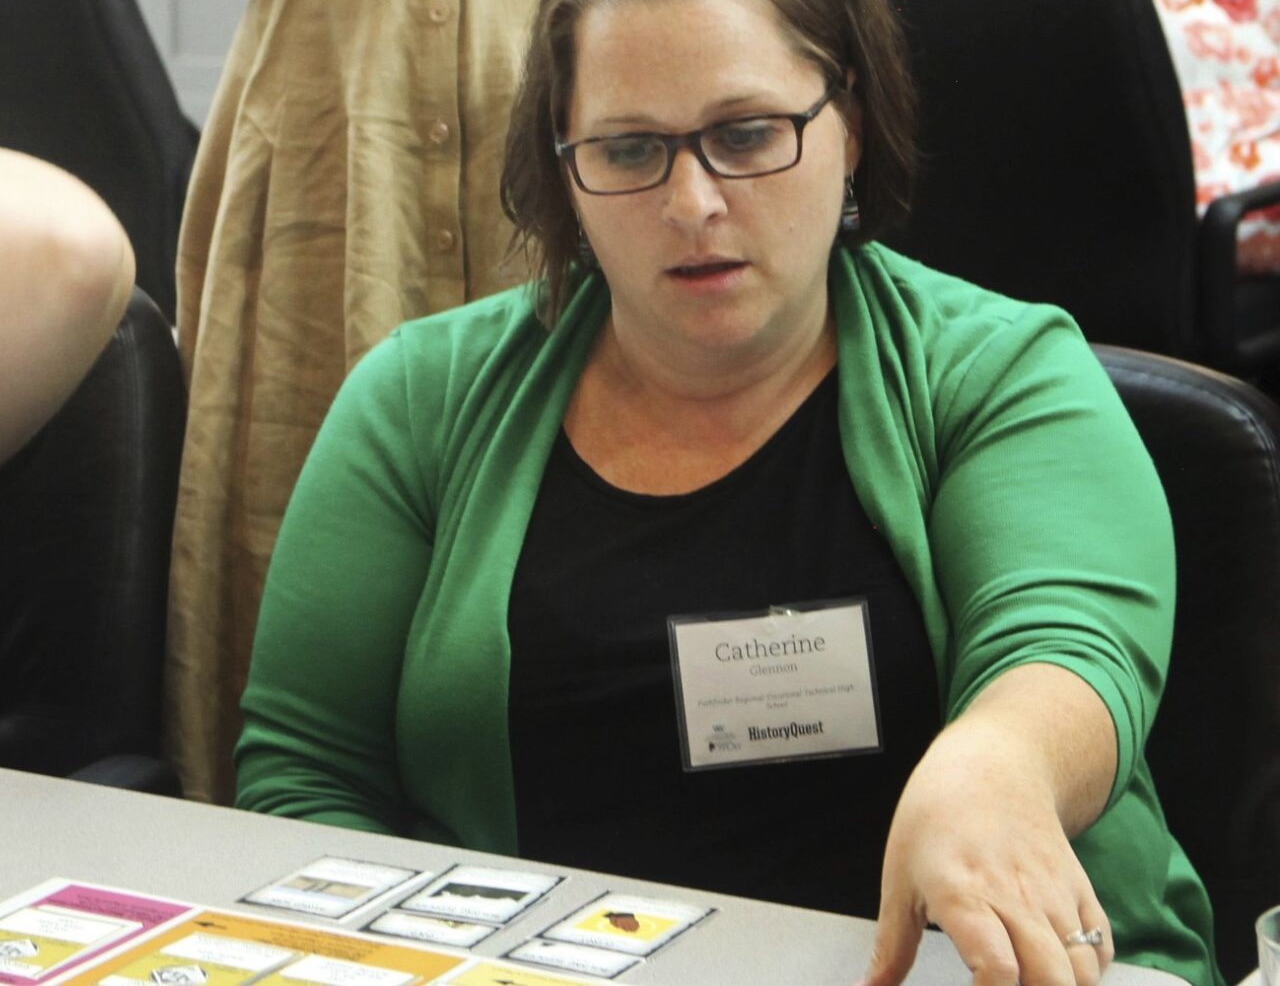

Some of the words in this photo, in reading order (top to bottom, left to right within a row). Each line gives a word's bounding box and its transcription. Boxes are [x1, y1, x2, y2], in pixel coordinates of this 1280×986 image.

[715, 634, 826, 662] Catherine
[750, 663, 798, 676] Glennon
[748, 720, 824, 742] HistoryQuest
